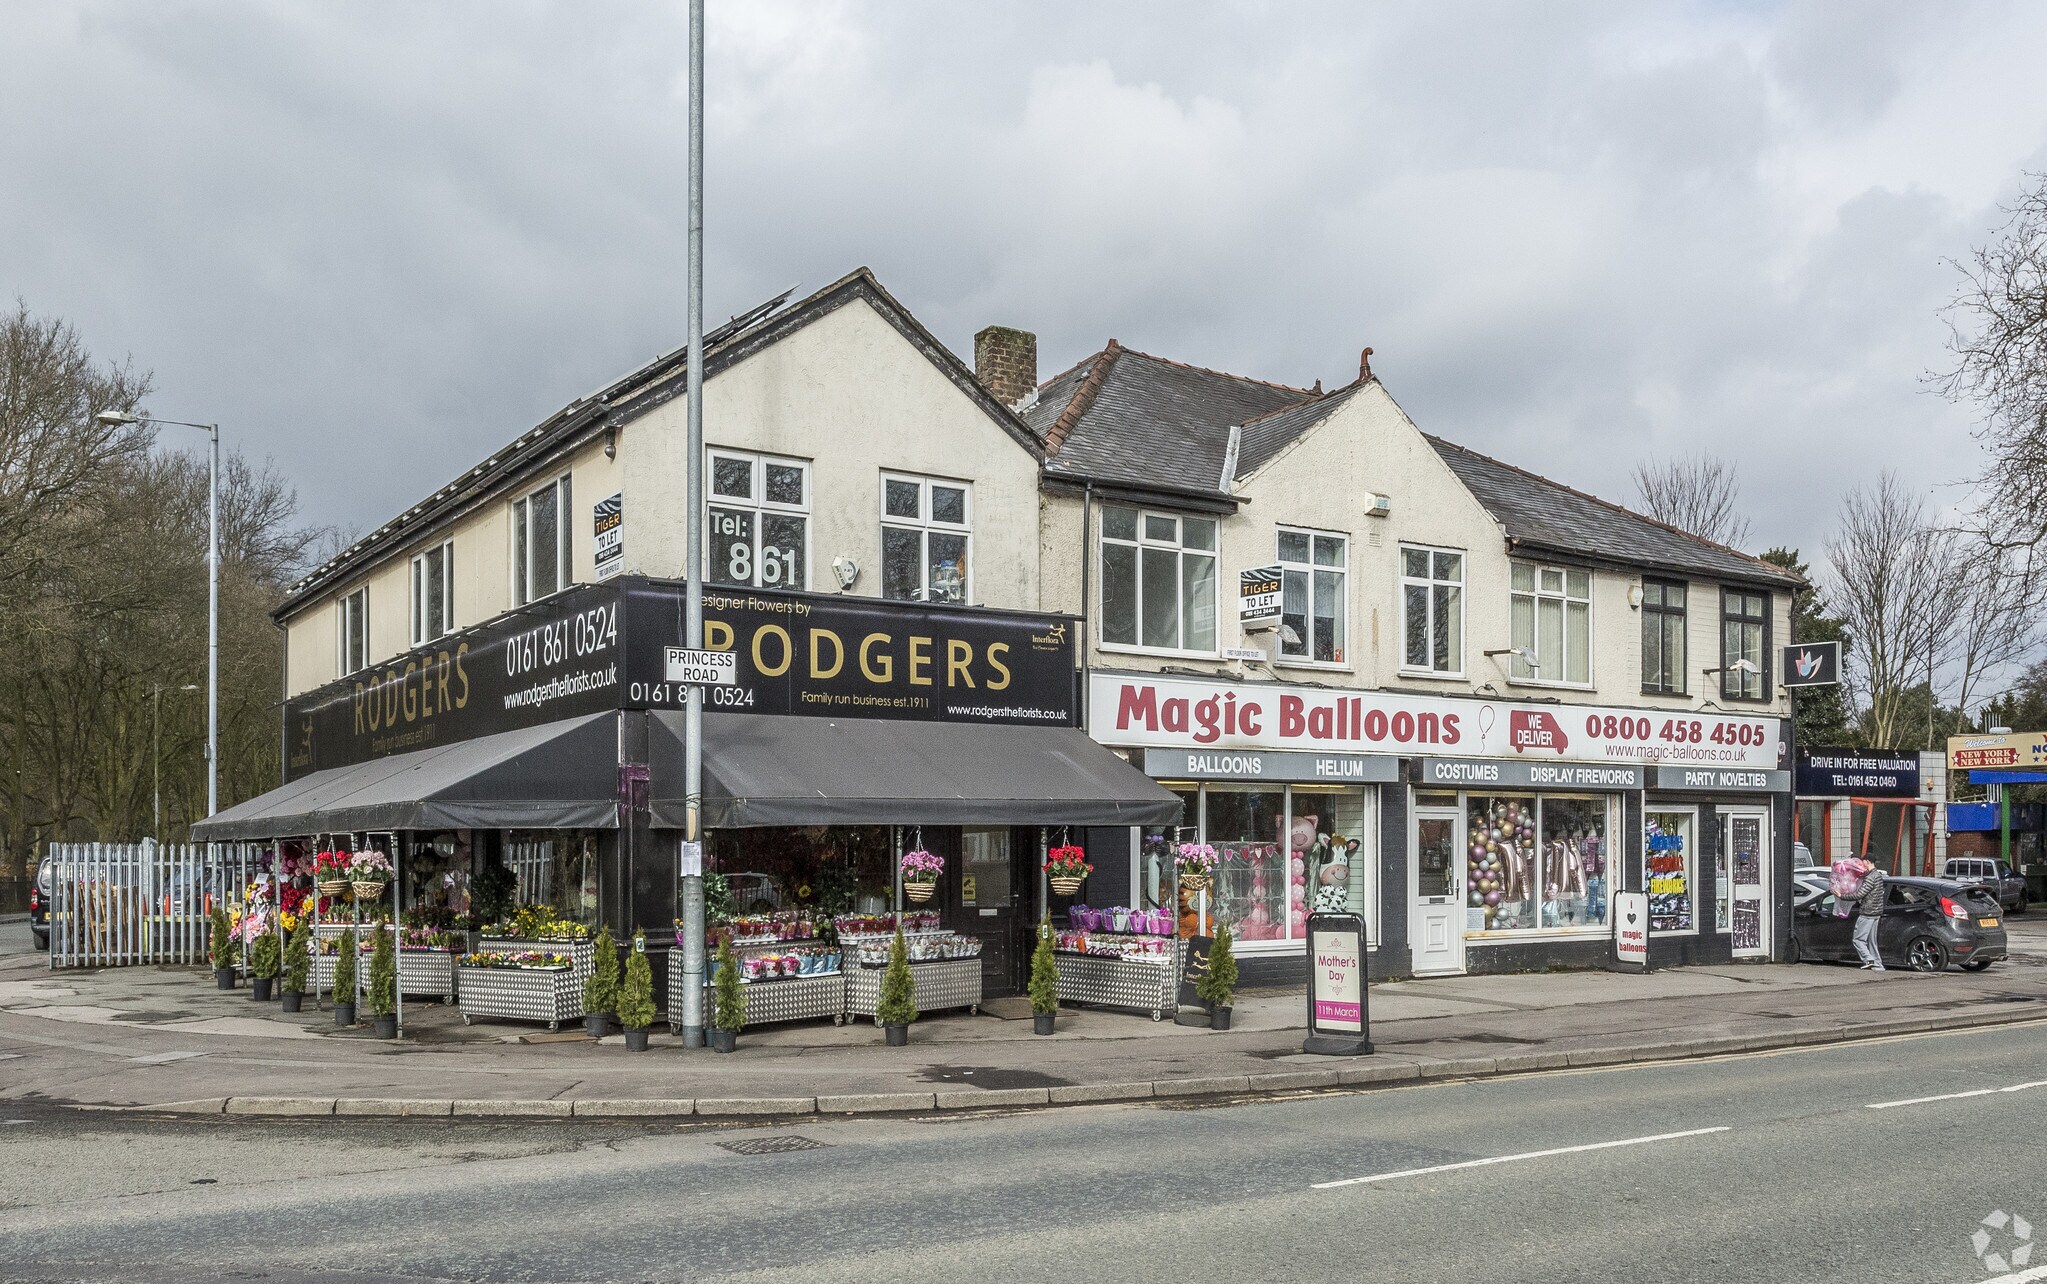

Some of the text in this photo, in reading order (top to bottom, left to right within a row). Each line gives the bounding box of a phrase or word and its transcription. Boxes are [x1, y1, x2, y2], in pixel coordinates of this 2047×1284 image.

[596, 513, 620, 533] TIGER
[711, 512, 747, 537] Tel:
[598, 530, 618, 550] TO LET
[1243, 581, 1278, 595] TIGER
[701, 593, 811, 617] esigner Flowers by
[1246, 595, 1275, 609] TO LET
[507, 602, 617, 677] 0161 861 0524
[669, 651, 733, 667] PRINCESS
[683, 668, 718, 682] ROAD
[354, 642, 469, 736] RODGERS
[504, 662, 617, 710] www.rodgerstheflorists.co.uk
[630, 682, 754, 706] 0161 81 0524
[801, 691, 831, 707] Family
[835, 694, 850, 705] run
[853, 692, 891, 707] business
[947, 705, 1067, 721] www.rodgerstheflorists.co.uk
[1116, 684, 1461, 745] Magic Balloons
[1528, 714, 1542, 730] WE
[1517, 729, 1553, 747] DELIVER
[1586, 714, 1765, 747] 0800 458 4505
[1965, 739, 1997, 748] Welcome
[1605, 744, 1746, 763] www.magic-balloons.co.uk
[1960, 749, 2011, 759] NEW YORK
[1960, 757, 2012, 766] NEW YORK
[1187, 755, 1363, 777] BALLOONS HELIUM
[1811, 756, 1916, 771] DRIVE IN FOR FREE VALUATION
[1436, 763, 1634, 786] COSTUMES DISPLAY FIREWORKS
[1685, 771, 1766, 788] PARTY NOVELTIES
[1832, 774, 1897, 788] TEL: 0161 452 0460
[1651, 878, 1685, 895] FIREWORKS
[1622, 930, 1642, 940] magic
[1619, 942, 1648, 952] balloons
[1318, 955, 1356, 968] Mother's
[1328, 970, 1345, 983] Day
[1318, 1004, 1358, 1019] 11th March
